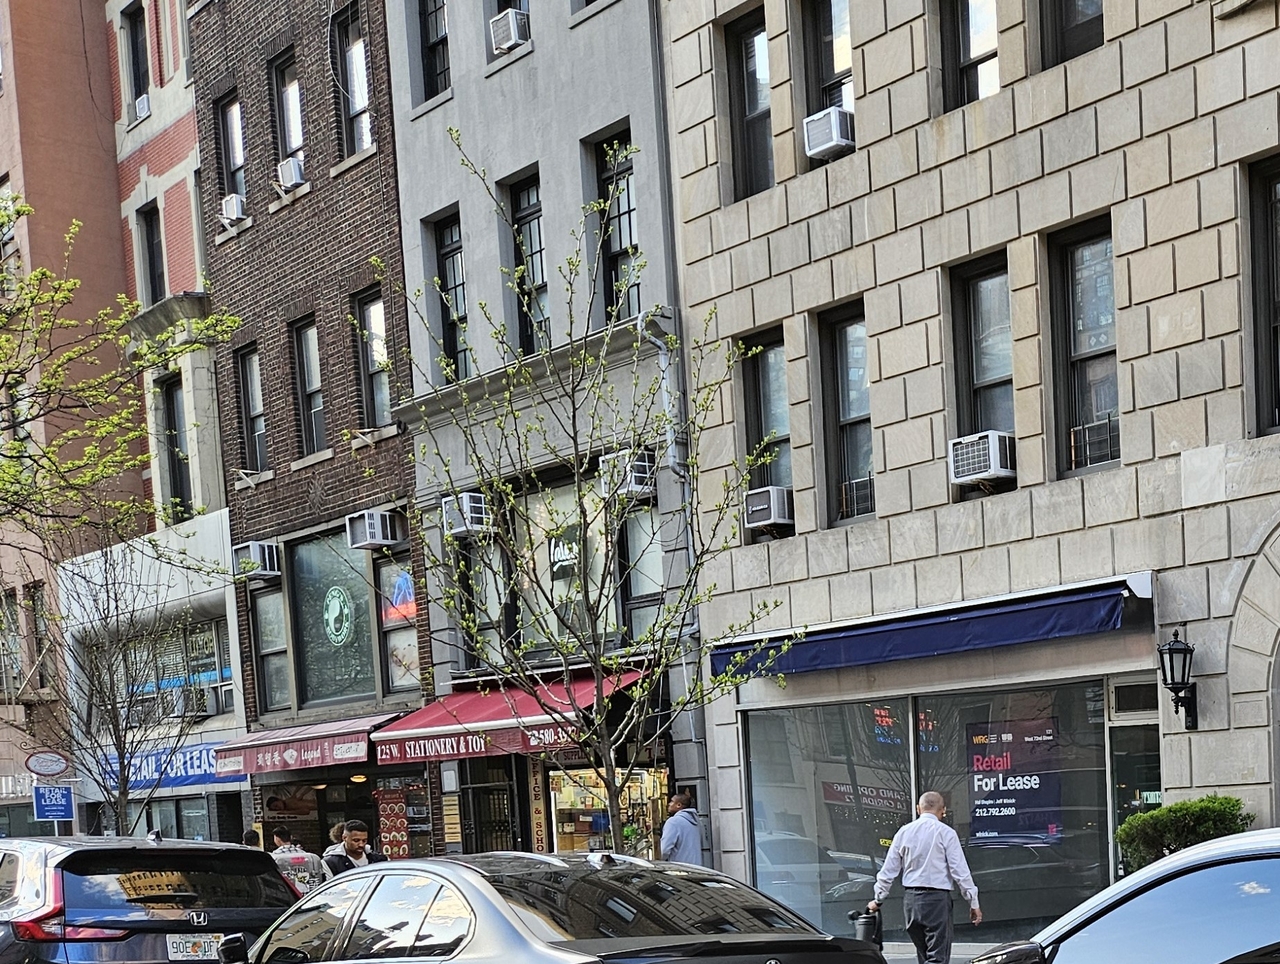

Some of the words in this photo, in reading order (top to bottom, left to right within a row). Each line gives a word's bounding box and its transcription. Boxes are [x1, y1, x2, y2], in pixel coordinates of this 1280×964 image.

[377, 745, 389, 759] 125
[405, 737, 458, 758] STATIONERY
[460, 736, 466, 753] &
[467, 734, 485, 753] TOY
[973, 735, 988, 744] WRG
[302, 745, 320, 761] Legend
[974, 752, 1011, 771] Retail
[162, 753, 186, 778] FOR
[187, 750, 216, 776] LEAS
[974, 775, 996, 791] For
[999, 774, 1040, 790] Lease
[975, 807, 1016, 816] 212.792.2600
[535, 822, 544, 852] SCHO
